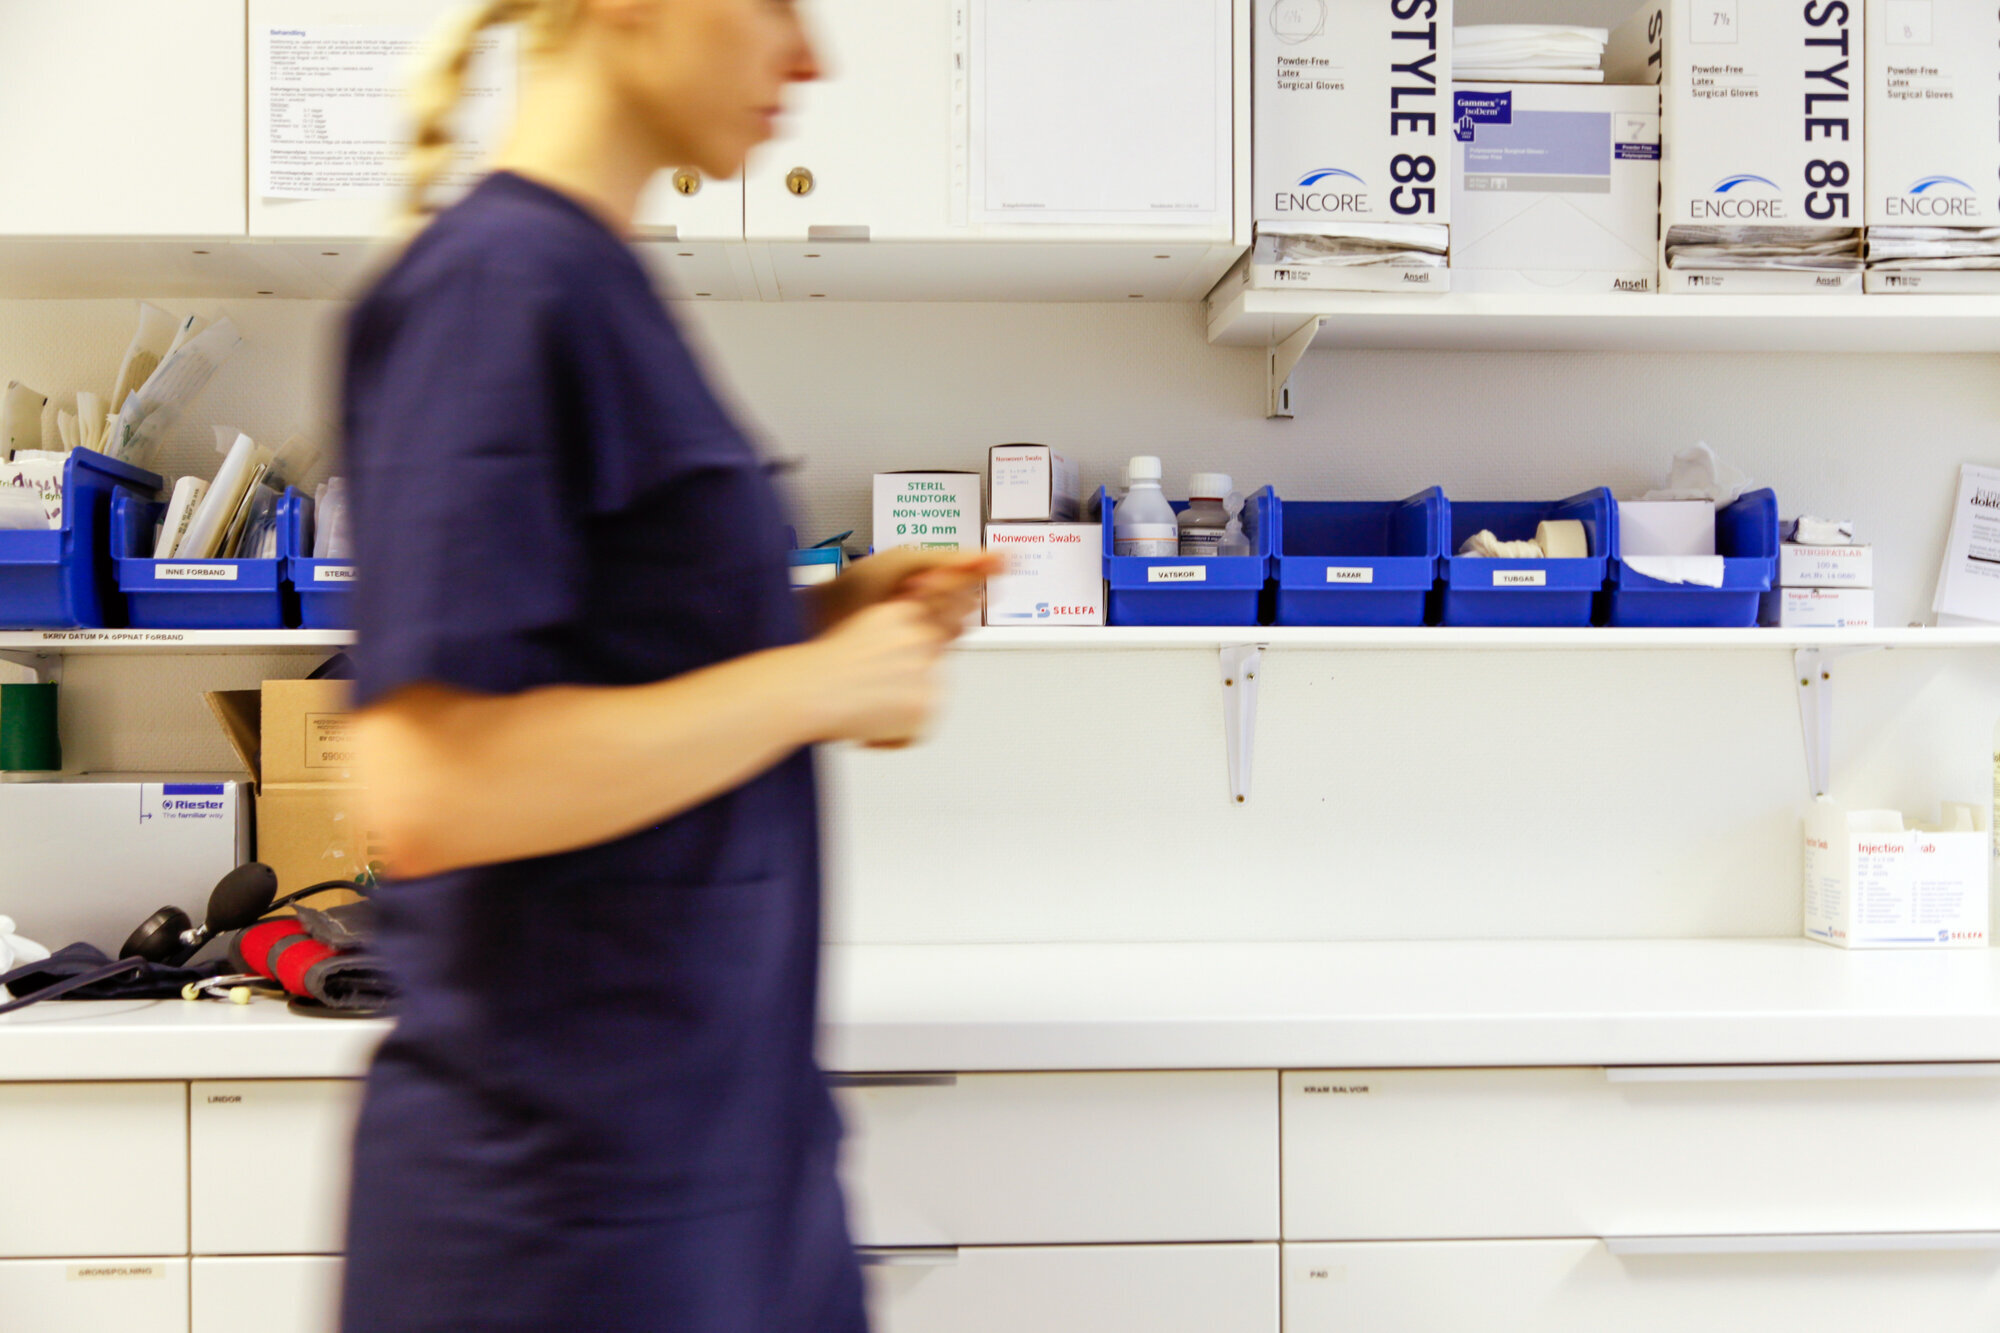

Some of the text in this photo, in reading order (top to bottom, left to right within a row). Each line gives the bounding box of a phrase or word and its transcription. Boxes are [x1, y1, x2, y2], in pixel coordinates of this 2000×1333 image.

[269, 29, 307, 37] Behandling
[1277, 57, 1330, 66] Powder-Free
[1277, 69, 1301, 78] Latex
[1692, 65, 1744, 74] Powder-Free
[1887, 66, 1939, 75] Powder-Free
[1277, 81, 1345, 91] Surgical Gloves
[1692, 77, 1715, 86] Latex
[1887, 79, 1910, 88] Latex
[1692, 89, 1760, 100] Surgical Gloves
[1887, 90, 1954, 101] Surgical Gloves
[1390, 0, 1437, 215] STYLE 85
[1803, 0, 1850, 220] STYLE 85
[1275, 193, 1368, 212] ENCORE
[1886, 197, 1977, 216] ENCORE
[1691, 199, 1783, 218] ENCORE
[1404, 272, 1430, 282] Ansell
[1816, 276, 1842, 286] Ansell
[1614, 278, 1648, 289] Ansell
[907, 482, 945, 491] STERIL
[896, 494, 957, 503] RUNDTORK
[892, 509, 961, 518] NON-WOVEN
[896, 523, 957, 535] Ø 30 mm
[993, 533, 1082, 543] Nonwoven Swabs
[165, 568, 186, 576] INNE
[1053, 606, 1095, 615] SELEFA
[43, 633, 67, 641] SKRIV
[69, 633, 96, 641] DATUM
[175, 800, 224, 810] Riester
[1858, 843, 1904, 855] Injection
[207, 1095, 242, 1104] LINDOR
